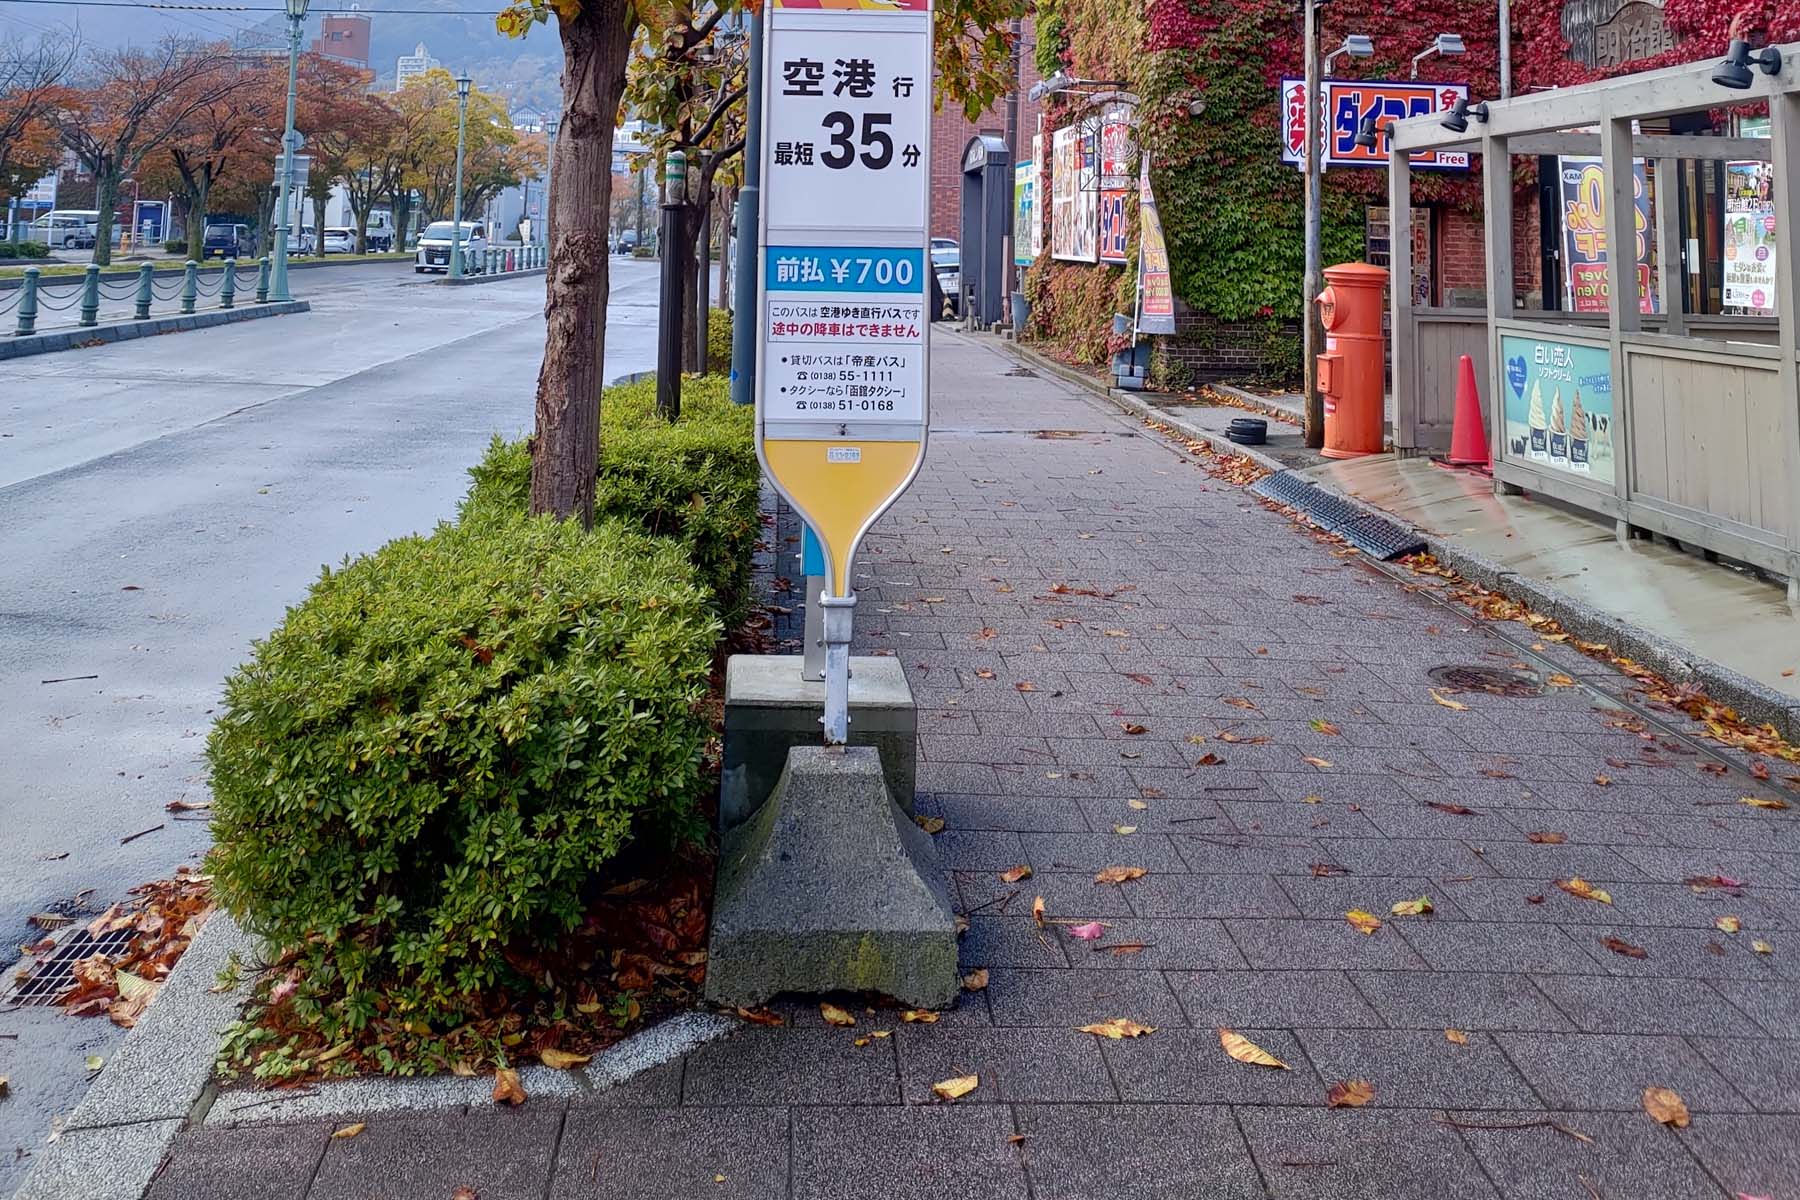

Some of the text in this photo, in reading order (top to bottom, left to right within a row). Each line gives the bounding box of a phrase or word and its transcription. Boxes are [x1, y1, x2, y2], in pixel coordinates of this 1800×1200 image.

[1439, 153, 1465, 164] Free
[771, 321, 920, 338] 途中の降車はできません
[790, 355, 907, 368] 貸切バスは「帝産バス」
[1536, 344, 1574, 368] 白い恋人
[810, 371, 893, 382] (0138) 55-1111
[789, 385, 907, 398] タクシーなら「函館タクシー」
[809, 400, 894, 412] (0138) 51-0168
